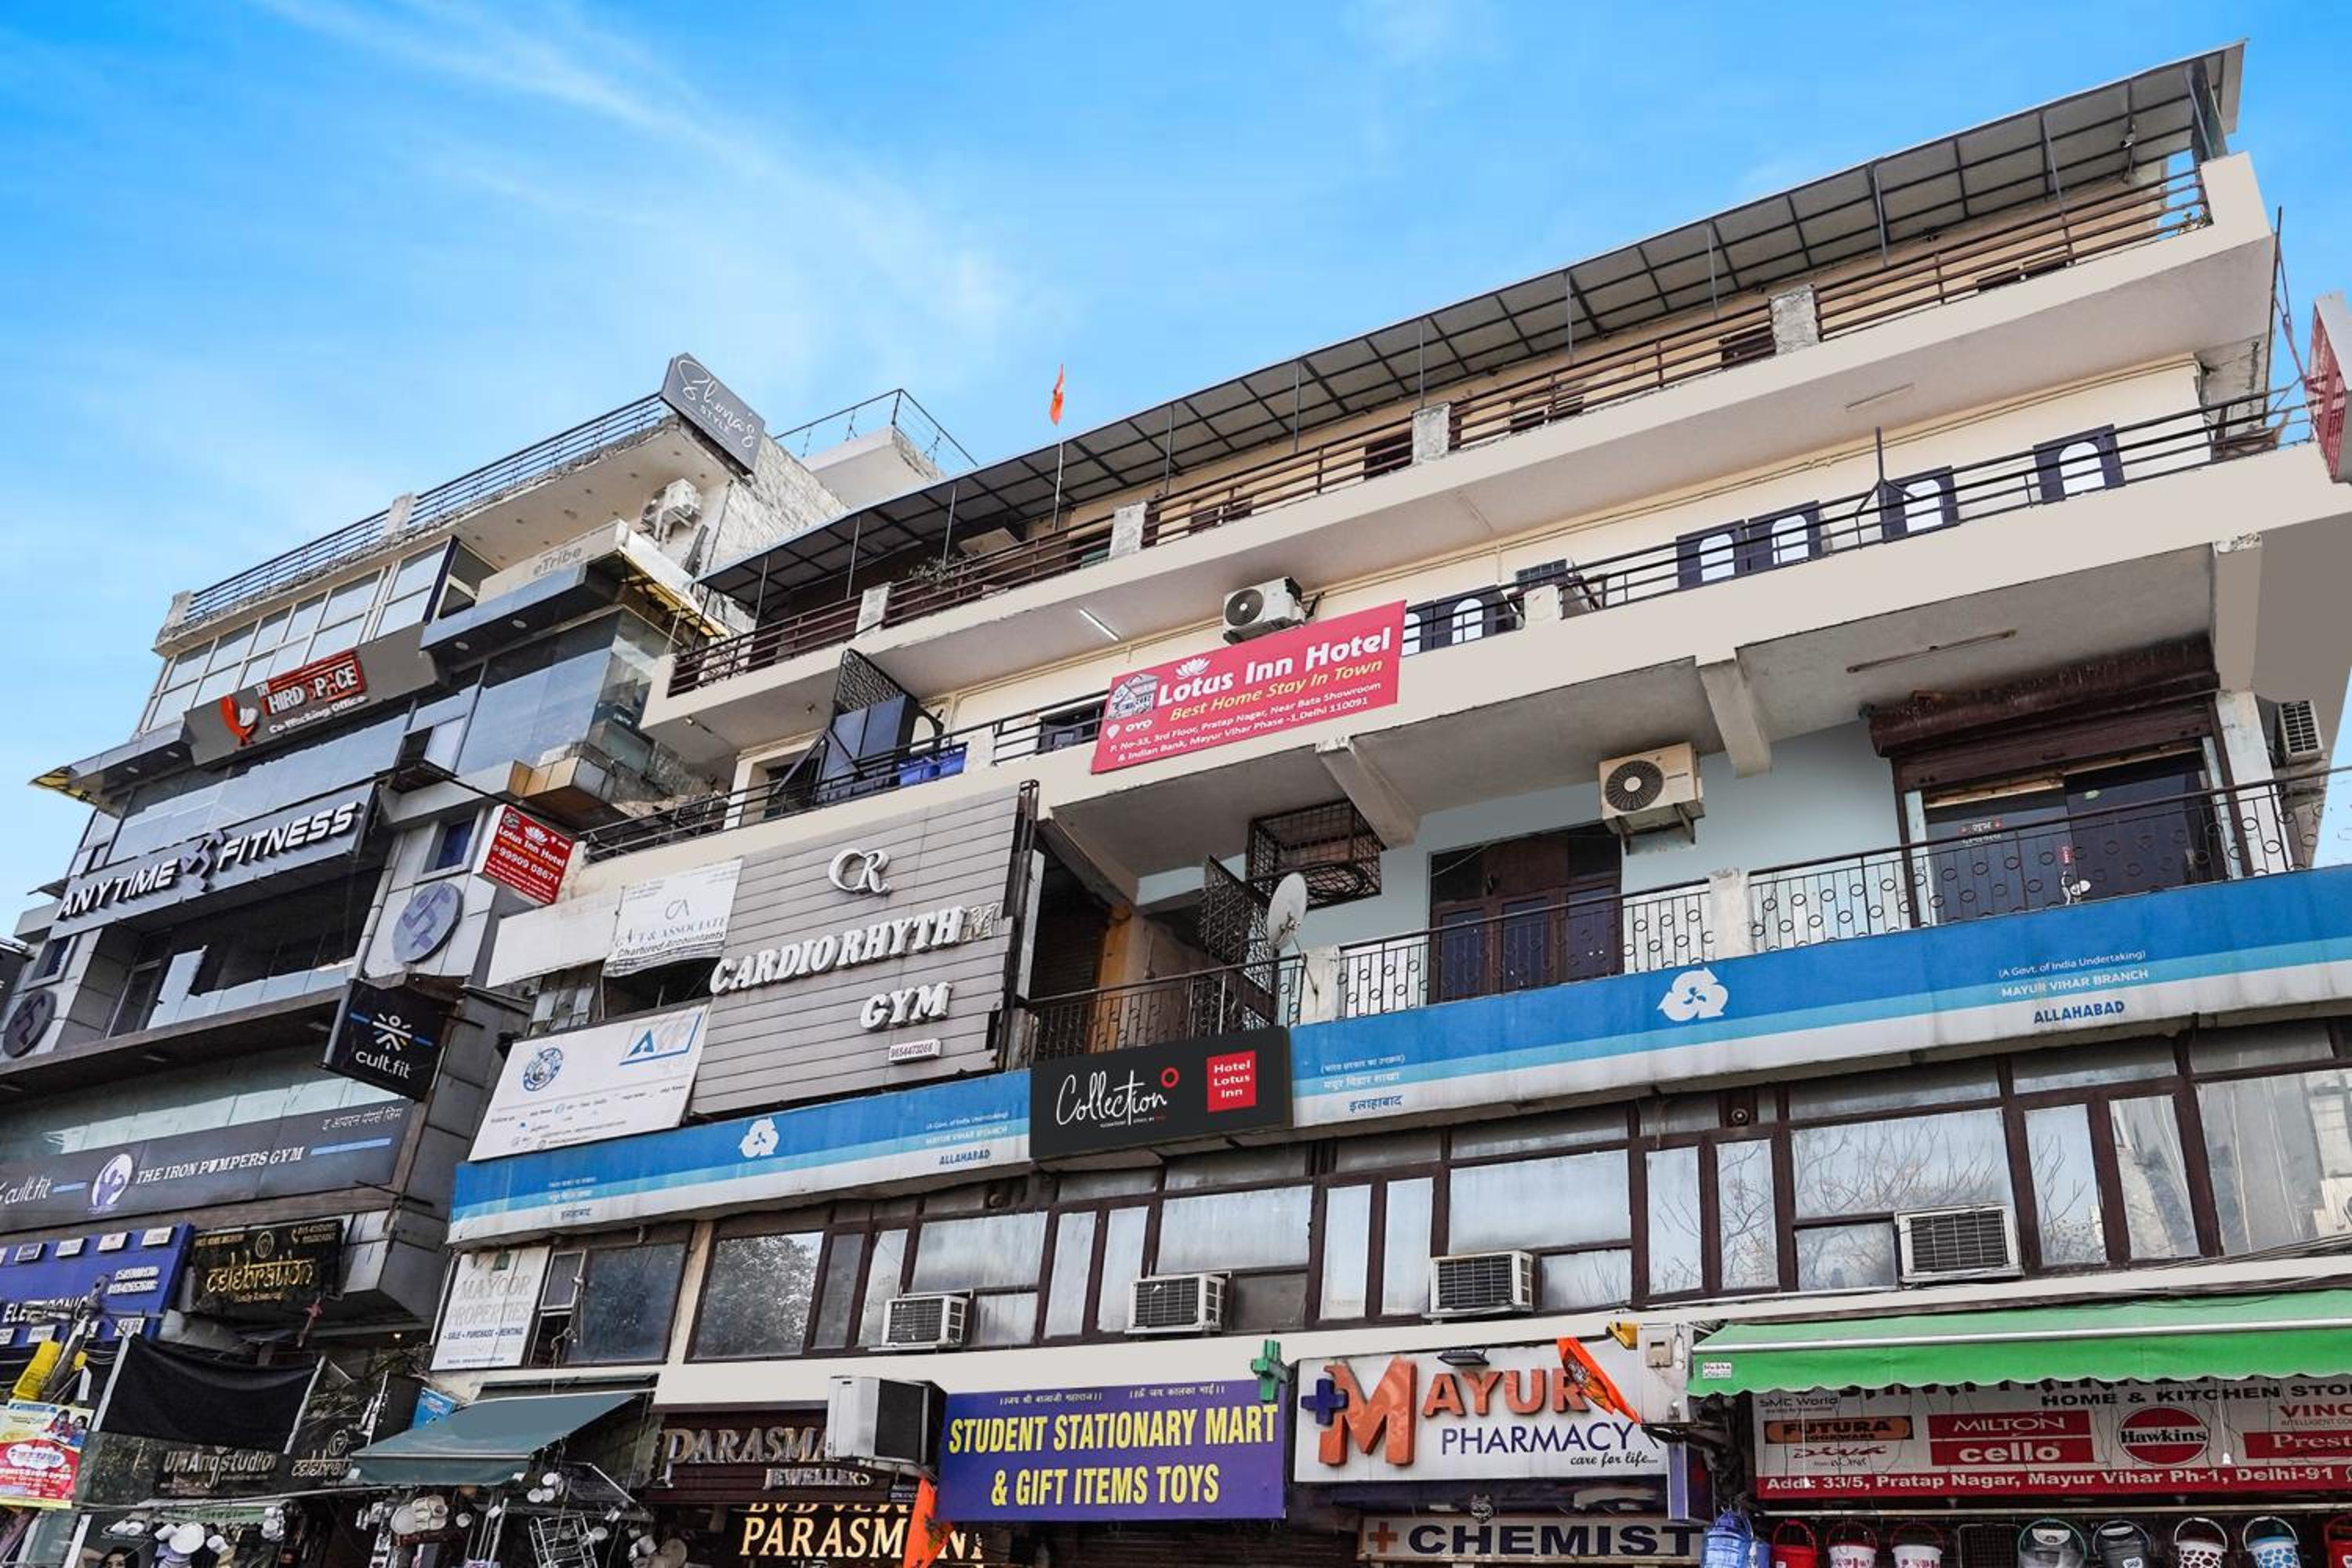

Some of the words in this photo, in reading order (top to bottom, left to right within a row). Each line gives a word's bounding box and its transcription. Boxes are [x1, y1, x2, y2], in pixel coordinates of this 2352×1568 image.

[1157, 671, 1234, 706] Lotus
[1244, 655, 1294, 684] Inn
[1305, 626, 1391, 673] Hotel
[1169, 701, 1207, 721] Best
[1210, 688, 1262, 712] Home
[1265, 675, 1307, 699] Stay
[1310, 673, 1329, 688] In
[1334, 659, 1383, 681] Town
[1153, 731, 1171, 743] 3rd
[1201, 717, 1235, 732] Pratap
[1236, 710, 1268, 725] Nagar,
[1270, 702, 1296, 714] Near
[1298, 696, 1321, 708] Bata
[1323, 682, 1381, 702] Showroom
[1127, 746, 1158, 760] Indian
[1160, 741, 1187, 753] Bank,
[1189, 733, 1221, 748] Mayur
[1225, 724, 1252, 737] Vihar
[1254, 717, 1285, 730] Phase
[1329, 697, 1368, 713] 110091
[56, 859, 180, 920] ANYTIME
[217, 801, 358, 871] FITNESS
[499, 826, 523, 844] Lotus
[540, 848, 565, 866] Hotel
[2011, 965, 2037, 978] Govt.
[2039, 961, 2050, 972] of
[2051, 959, 2077, 972] India
[2078, 949, 2147, 967] Undertaking)
[2002, 982, 2047, 998] MAYUR
[2049, 977, 2091, 992] VIHAR
[2092, 968, 2150, 986] BRANCH
[860, 982, 954, 1033] GYM
[2034, 1000, 2125, 1025] ALLAHABAD
[355, 1051, 412, 1080] cult.fit
[1213, 1074, 1250, 1087] Lotus
[1214, 1060, 1250, 1075] Hotel
[1056, 1069, 1167, 1126] Collection
[1348, 1094, 1403, 1113] इलाहाबाद
[136, 1167, 163, 1185] THE
[164, 1163, 198, 1181] IRON
[198, 1150, 268, 1174] PUMPERS
[269, 1146, 305, 1165] GYM
[1759, 1398, 1793, 1408] SMC
[1796, 1396, 1838, 1407] World
[2041, 1392, 2118, 1407] HOME
[2127, 1391, 2146, 1403] &
[2156, 1386, 2280, 1403] KITCHEN
[2290, 1383, 2352, 1397] STO
[1318, 1355, 1592, 1466] MAYUR
[1953, 1416, 2065, 1432] MILTON
[949, 1416, 1047, 1456] STUDENT
[1054, 1409, 1196, 1452] STATIONARY
[1205, 1404, 1278, 1445] MART
[1441, 1421, 1634, 1456] PHARMACY
[1781, 1421, 1893, 1436] FUTURA
[2121, 1429, 2207, 1443] Hawkins
[1570, 1456, 1598, 1465] care
[1601, 1451, 1622, 1468] for
[1958, 1442, 2061, 1463] cello
[764, 1468, 872, 1490] JEWELLERS
[991, 1469, 1007, 1506] &
[1015, 1468, 1068, 1505] GIFT
[1074, 1466, 1147, 1504] ITEMS
[1156, 1463, 1220, 1504] TOYS
[1823, 1476, 1871, 1490] 33/5,
[1876, 1474, 1944, 1490] Pratap
[1951, 1473, 2021, 1489] Nagar,
[2028, 1472, 2095, 1488] Mayur
[2102, 1471, 2162, 1485] Vihar
[2170, 1469, 2229, 1485] Ph-1,
[2235, 1467, 2333, 1483] Delhi-91
[739, 1517, 983, 1559] PARASMNI
[1408, 1524, 1707, 1557] CHEMIST
